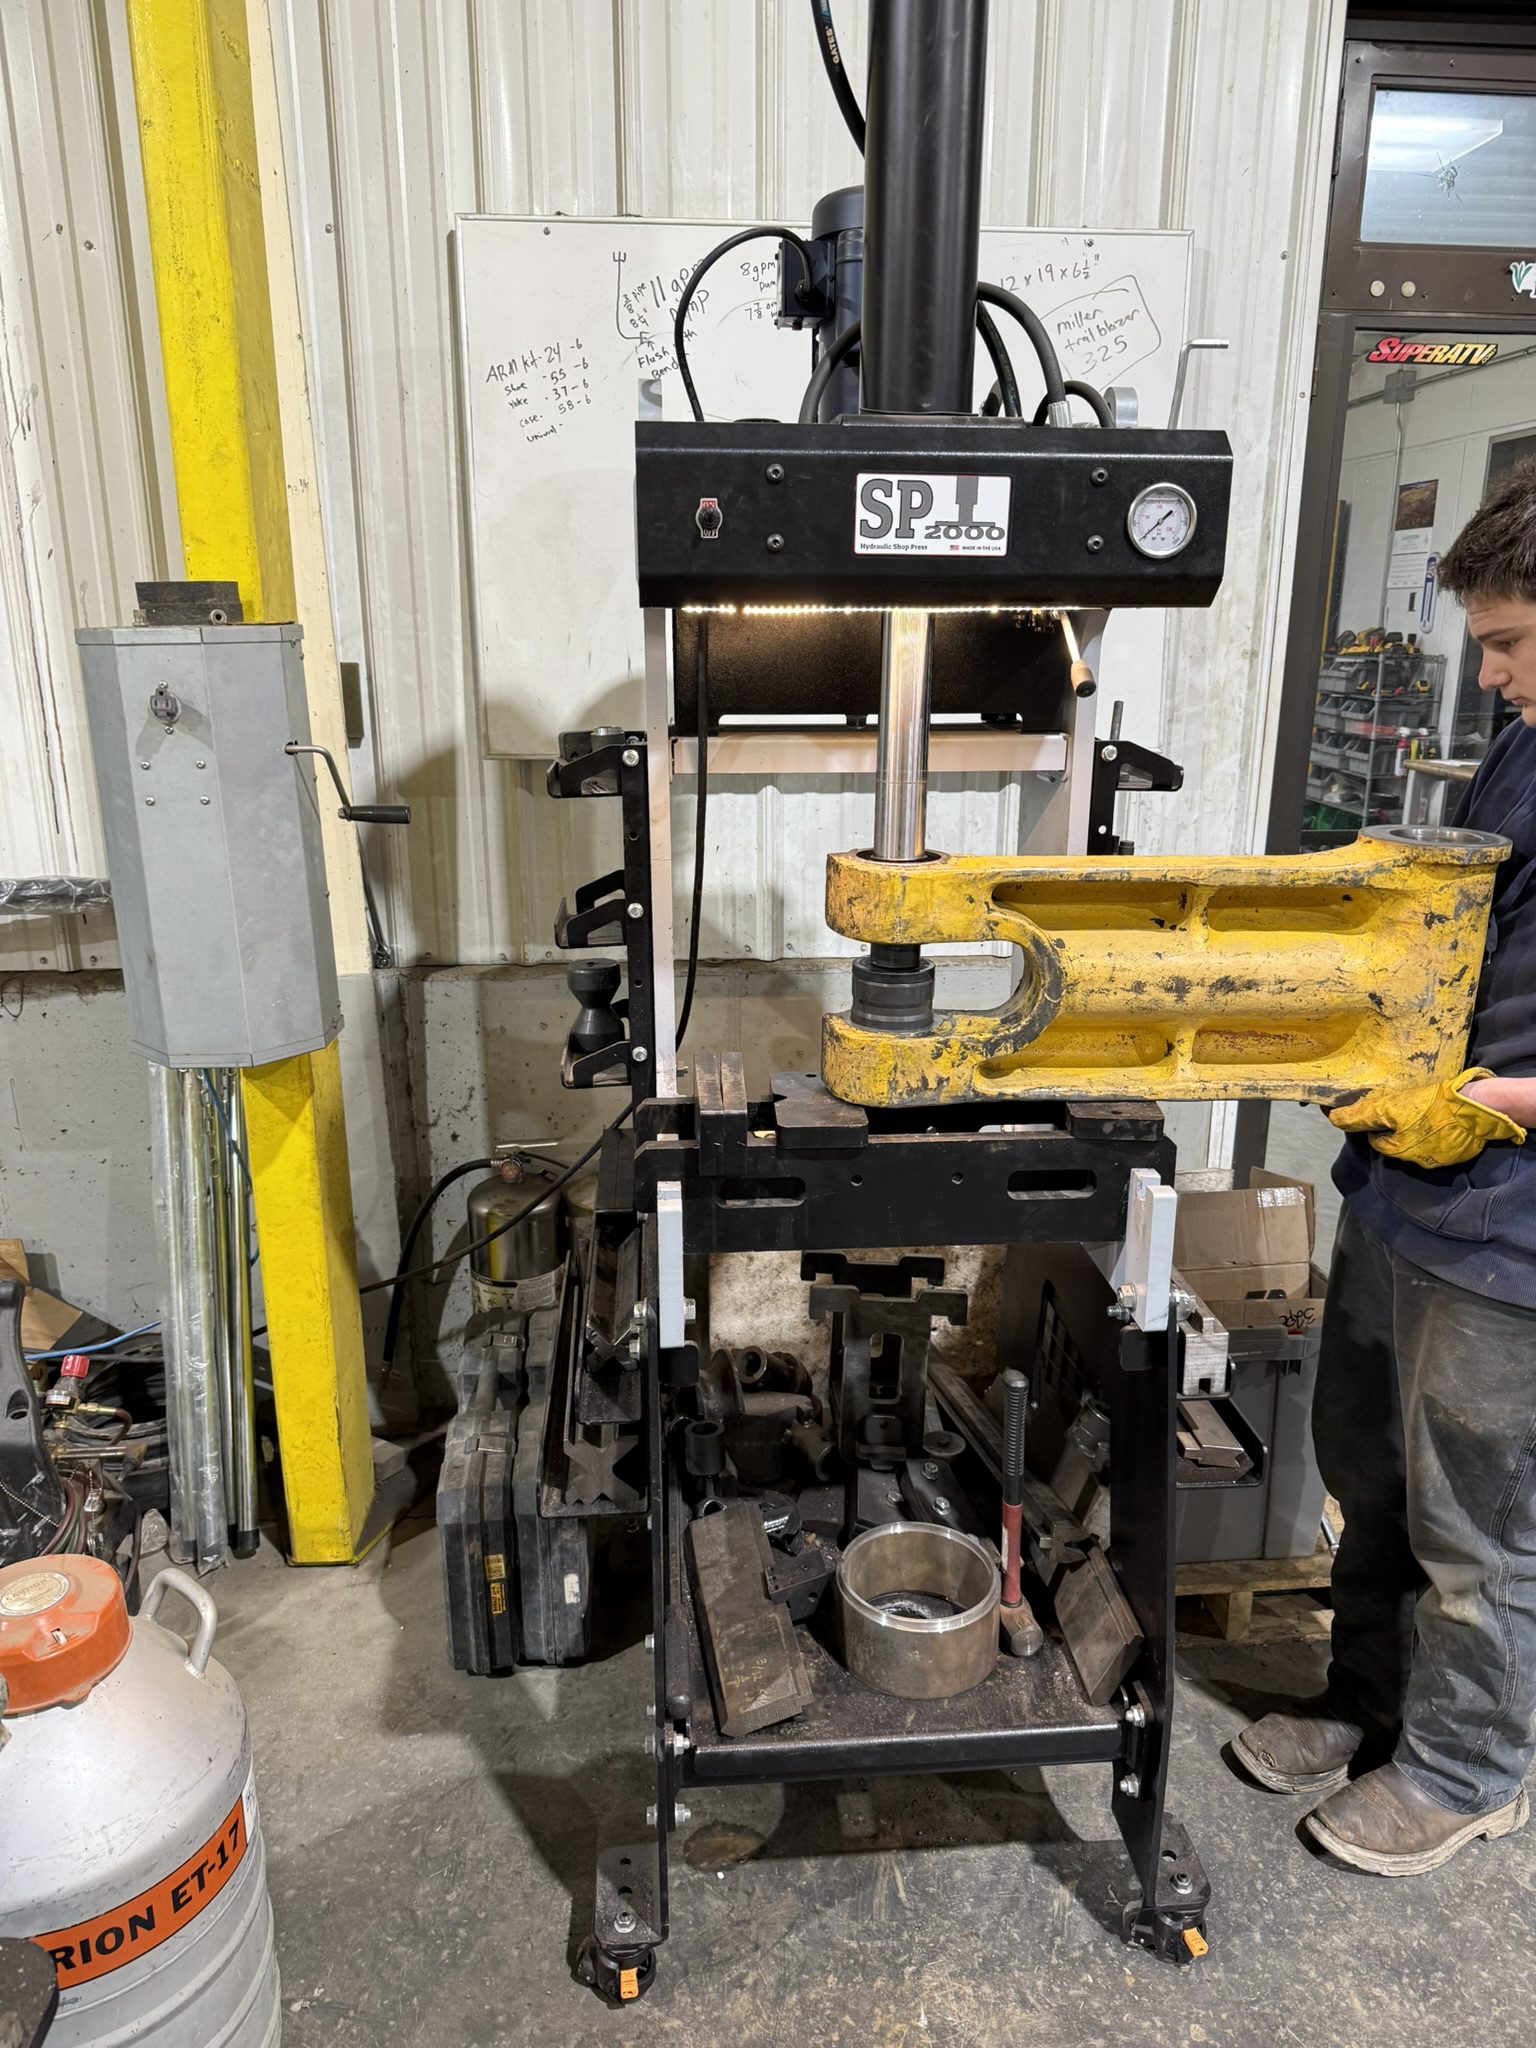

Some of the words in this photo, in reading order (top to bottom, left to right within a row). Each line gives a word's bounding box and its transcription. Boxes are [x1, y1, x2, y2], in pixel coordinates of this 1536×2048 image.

[826, 27, 840, 64] GATES
[759, 280, 777, 293] pum
[1000, 275, 1020, 292] 12
[1038, 263, 1055, 282] 19
[669, 289, 710, 322] pmp
[1057, 308, 1104, 335] miller
[638, 346, 670, 369] Flush
[1080, 335, 1128, 375] 325
[924, 525, 1006, 541] 2000
[860, 543, 892, 551] Hydraulic
[893, 543, 910, 552] Shop
[910, 543, 928, 551] Press
[48, 1905, 156, 1974] RION
[171, 1817, 240, 1915] ET-17
